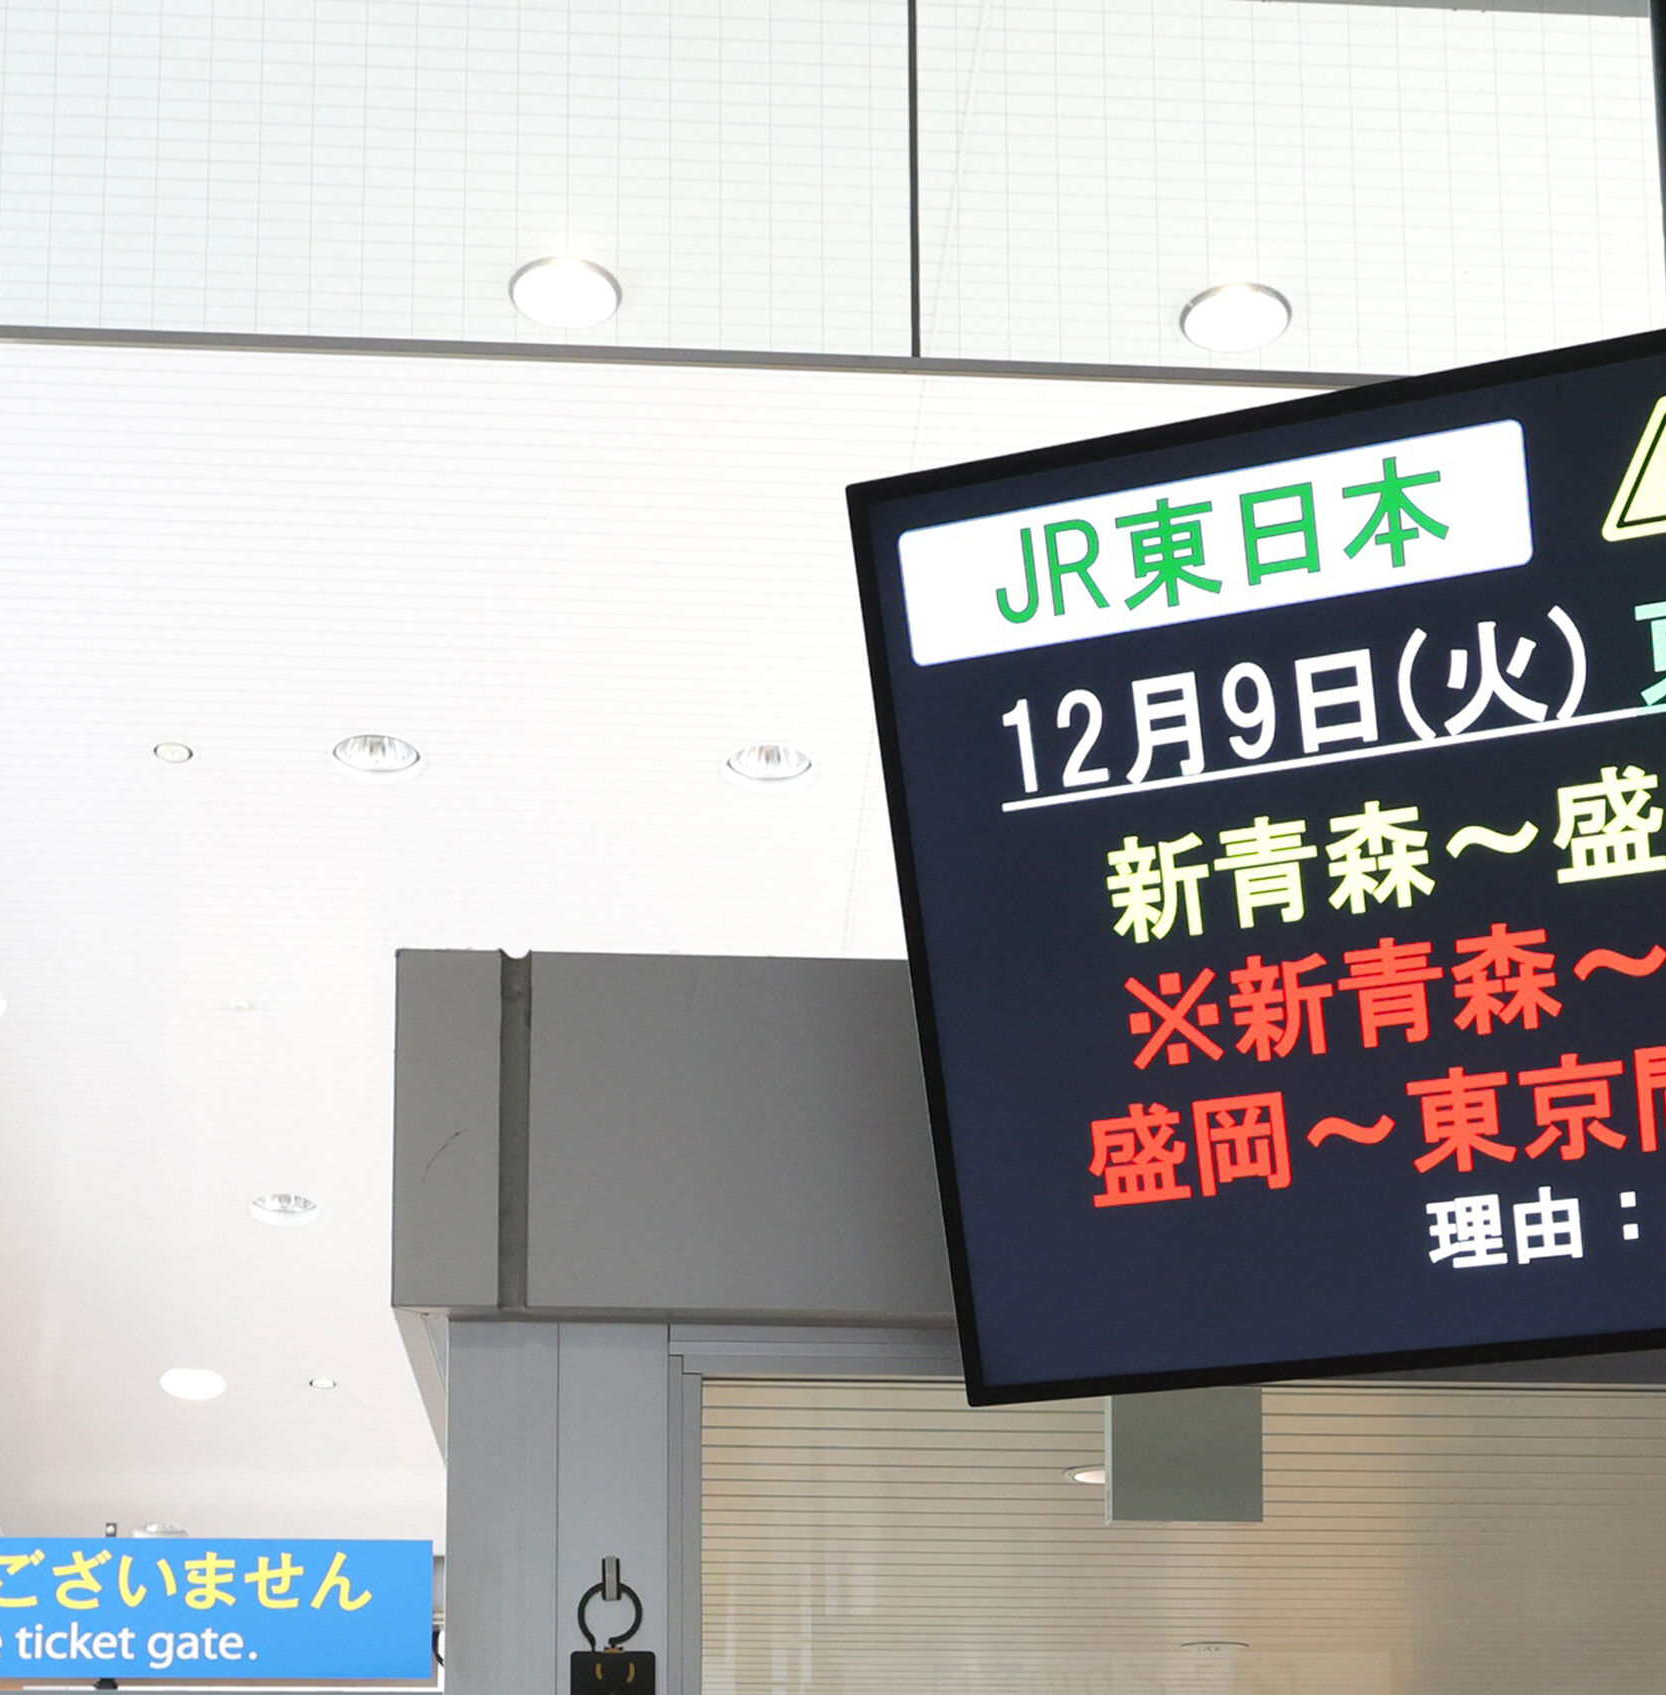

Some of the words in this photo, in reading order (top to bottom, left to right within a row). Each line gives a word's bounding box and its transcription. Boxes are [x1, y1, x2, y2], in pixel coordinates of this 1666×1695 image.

[996, 455, 1451, 627] JR東日本
[14, 1621, 135, 1660] ticket
[148, 1625, 259, 1668] gate.
